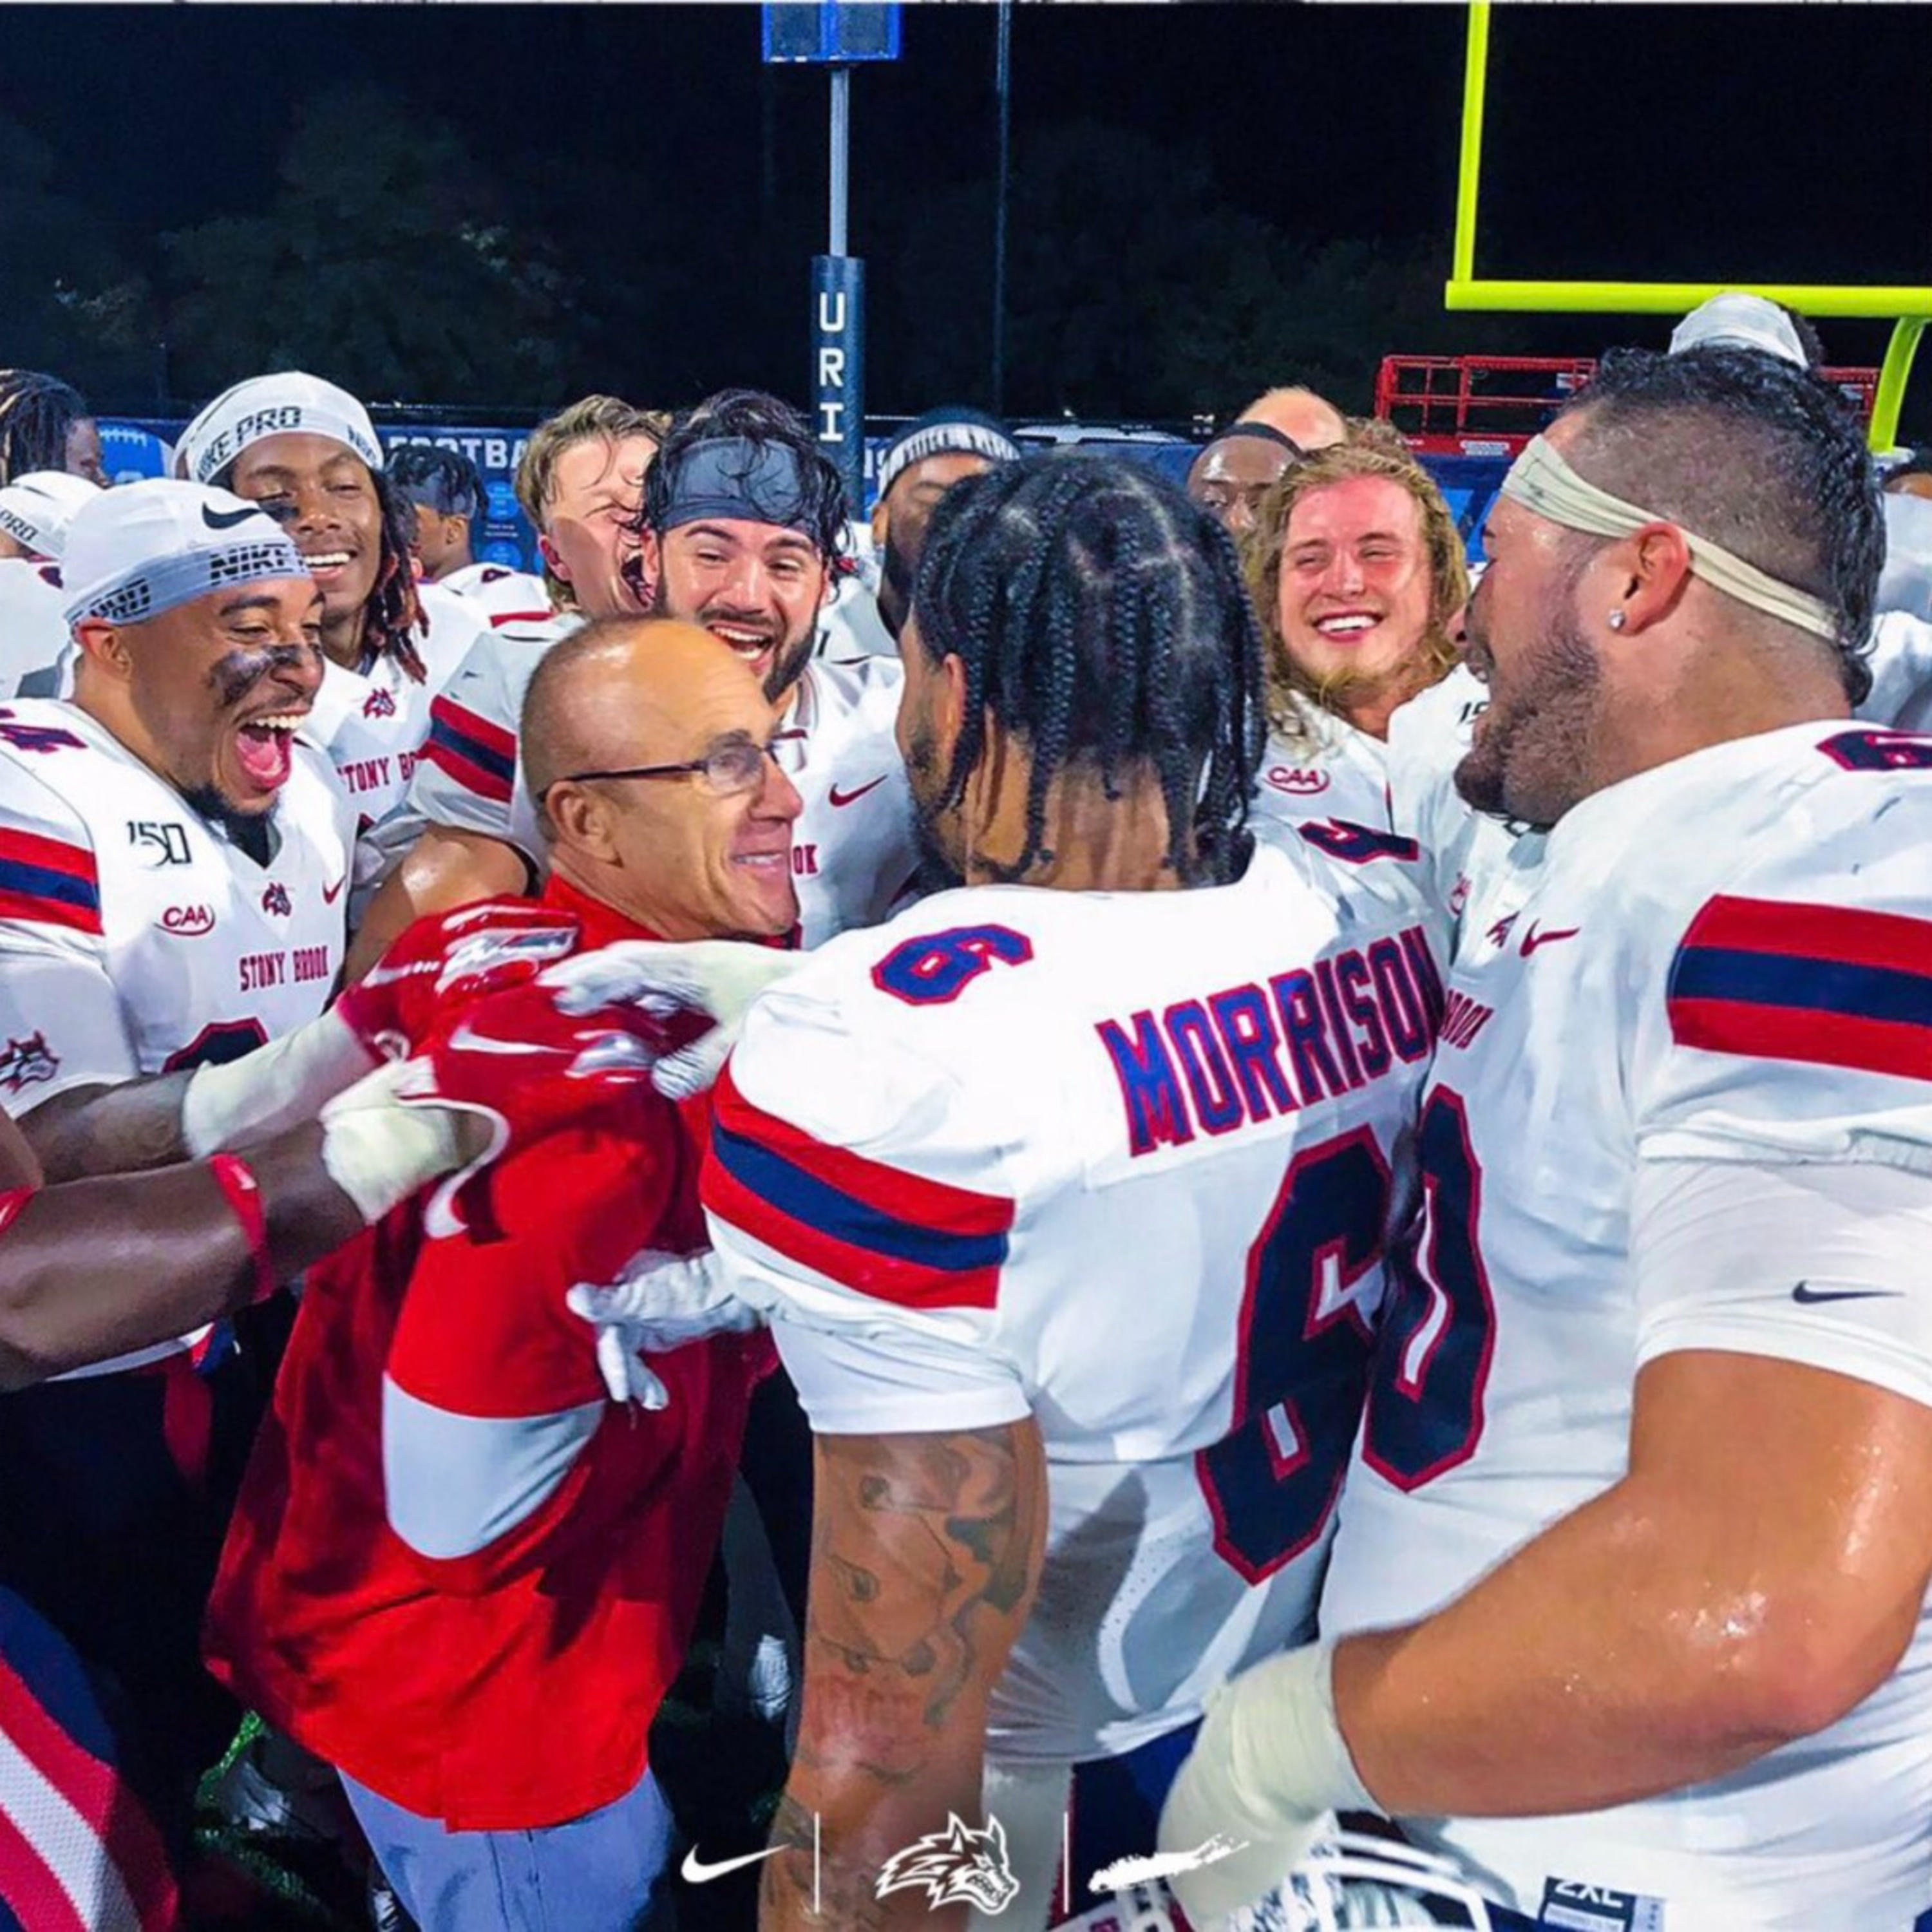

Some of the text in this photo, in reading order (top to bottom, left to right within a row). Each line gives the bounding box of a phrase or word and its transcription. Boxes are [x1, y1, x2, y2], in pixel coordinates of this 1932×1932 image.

[819, 292, 846, 442] URI
[236, 406, 302, 446] PRO
[209, 543, 294, 587] NIKE
[336, 756, 390, 793] TONY
[1268, 766, 1320, 786] CAA
[127, 820, 193, 867] 150
[162, 904, 210, 927] CAA
[239, 945, 329, 992] STONY BROOK
[1094, 924, 1444, 1157] MORRISON
[1194, 1122, 1392, 1587] 6
